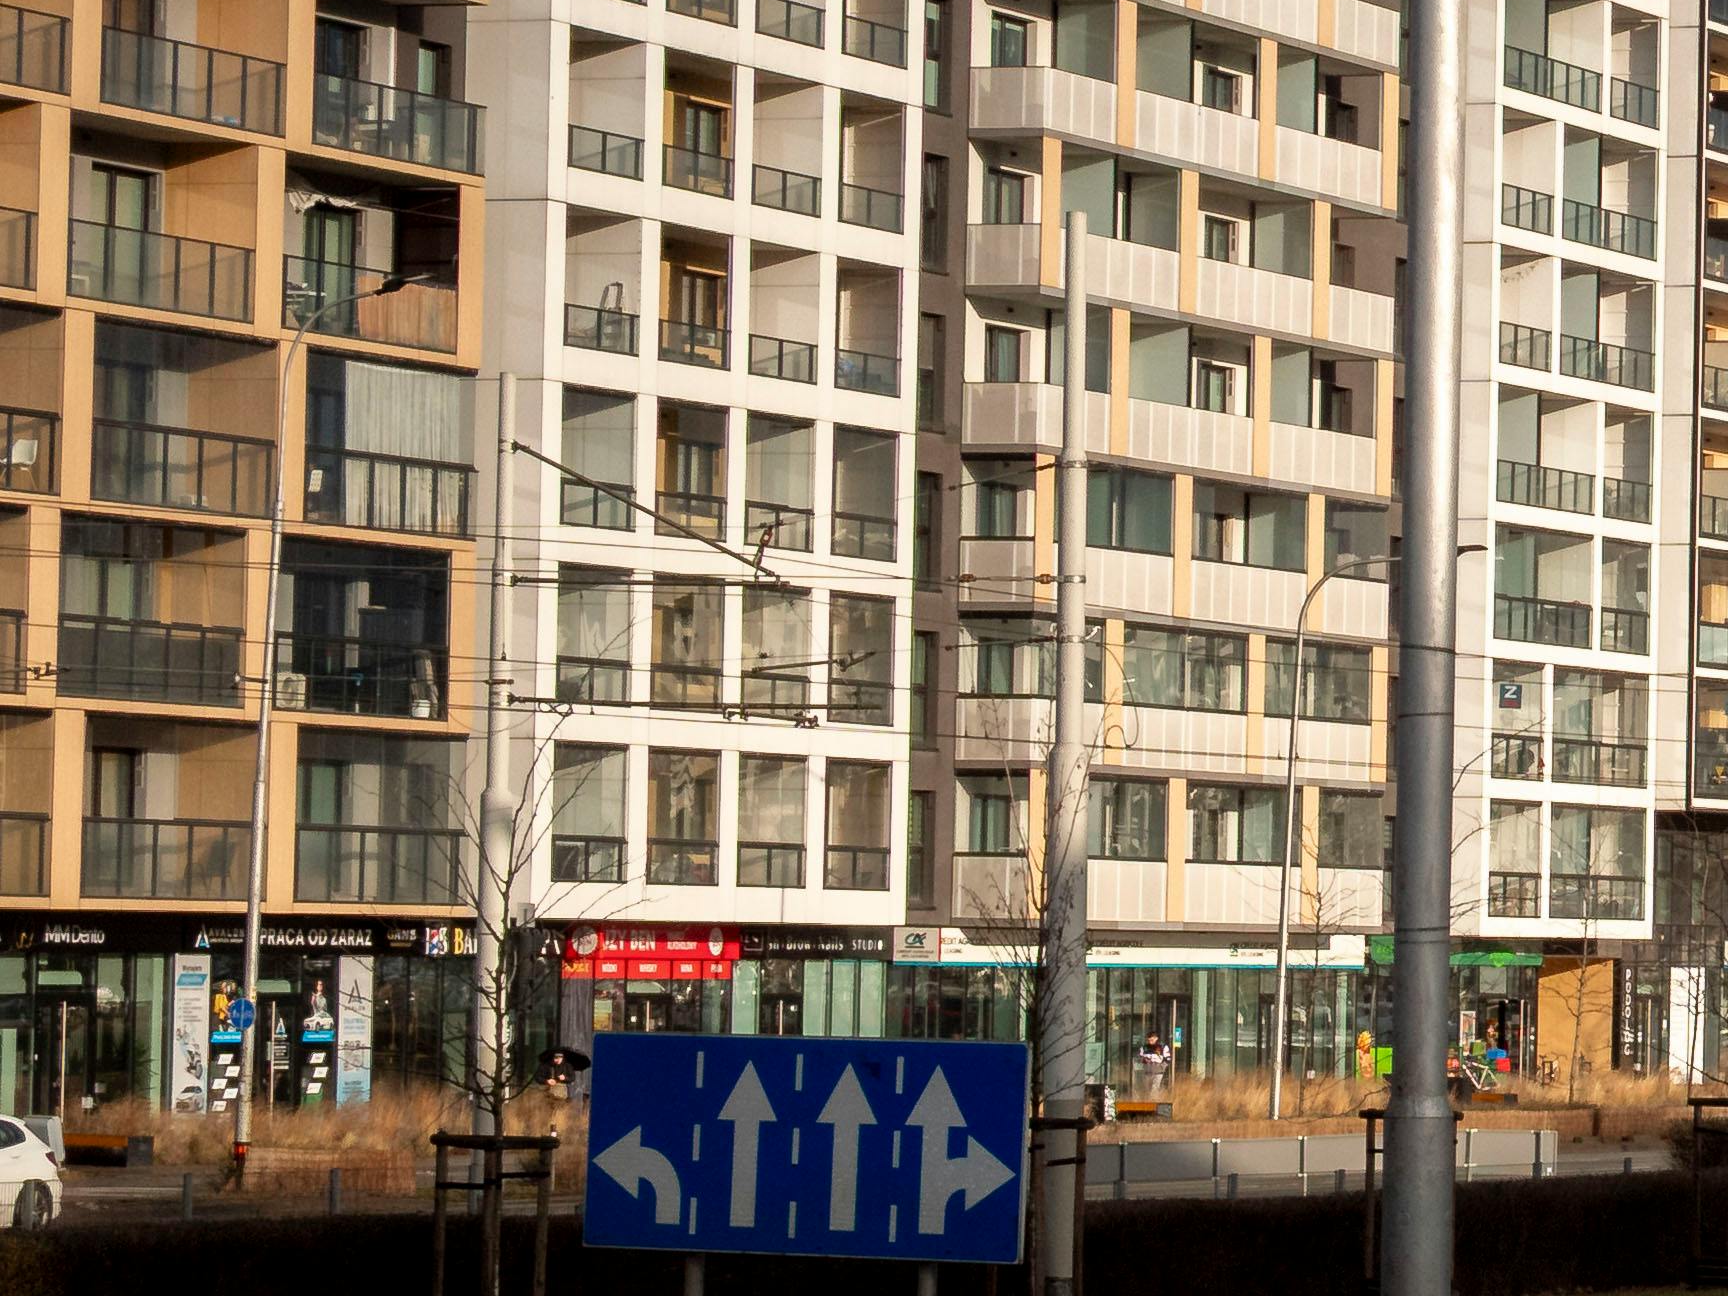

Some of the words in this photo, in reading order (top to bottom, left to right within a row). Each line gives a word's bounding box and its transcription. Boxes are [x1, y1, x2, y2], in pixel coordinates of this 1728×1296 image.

[44, 923, 70, 943] MM
[71, 924, 106, 944] Dento
[259, 928, 305, 947] PRACA
[307, 929, 328, 947] OD
[330, 929, 373, 947] ZARAZ
[630, 929, 656, 951] BEN
[851, 938, 883, 951] STUDIO
